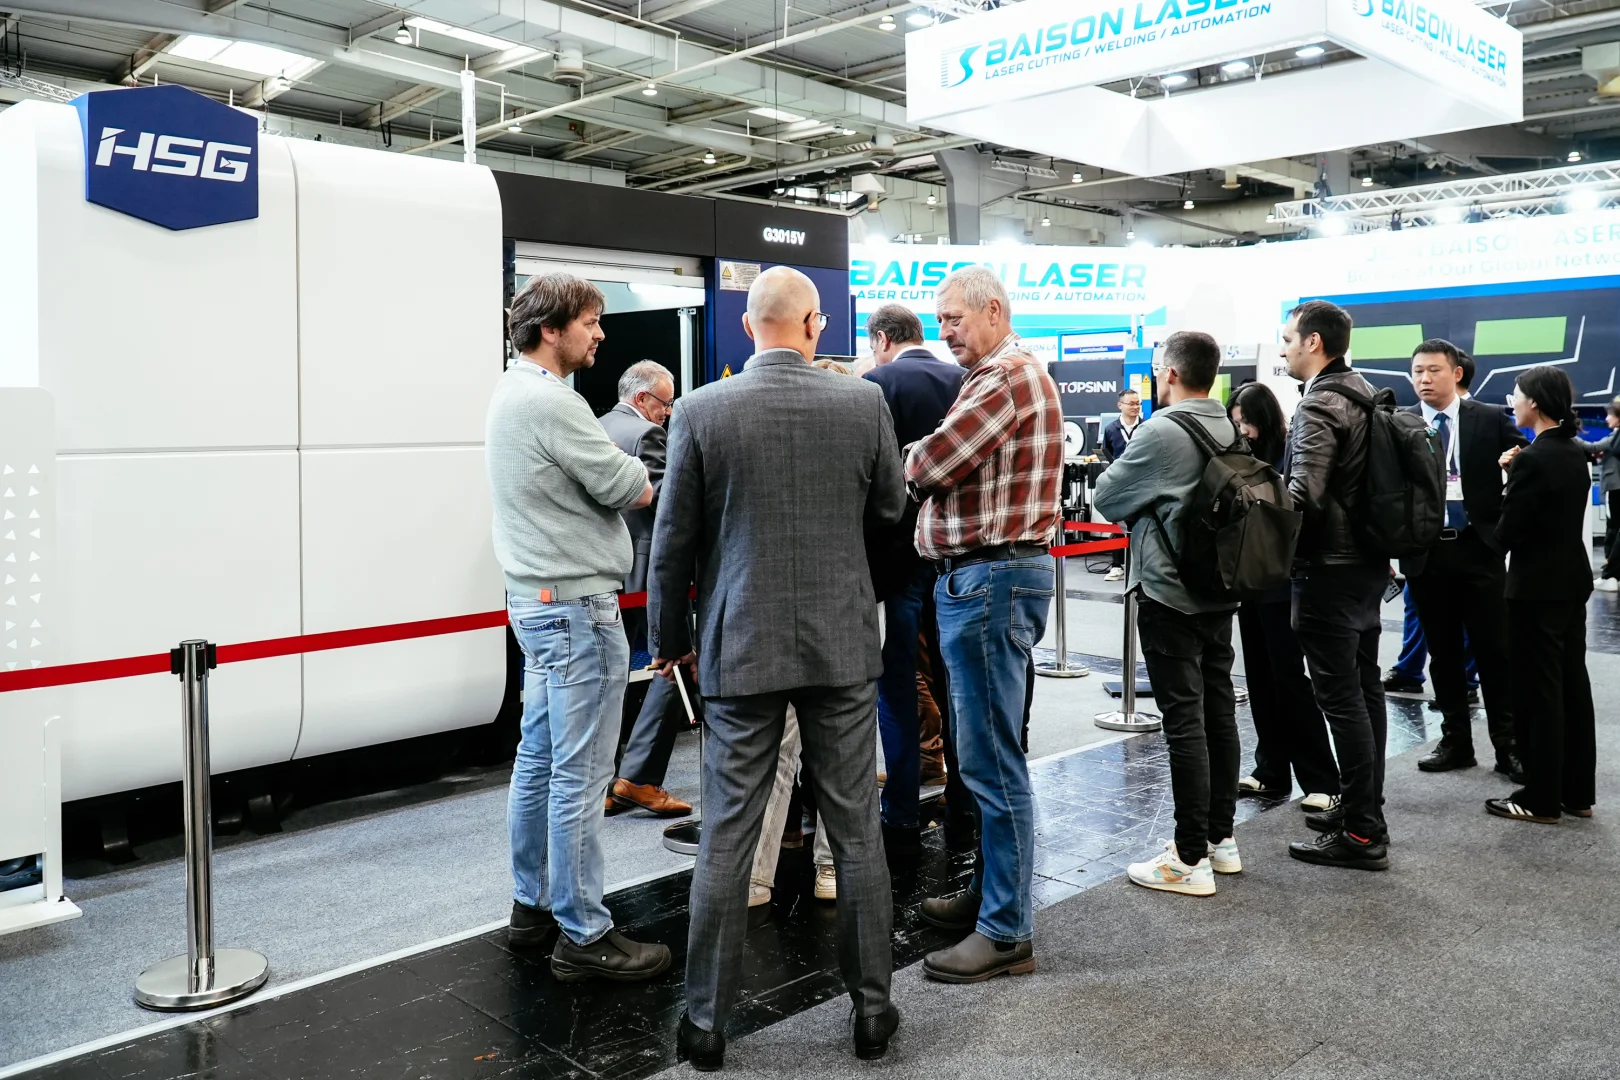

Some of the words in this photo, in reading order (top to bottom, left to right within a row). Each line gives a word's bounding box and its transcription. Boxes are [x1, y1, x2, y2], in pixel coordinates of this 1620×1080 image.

[985, 6, 1125, 67] BAISON
[1133, 0, 1250, 30] LAS
[985, 62, 1024, 80] LASER
[1027, 47, 1081, 70] CUTTING
[1094, 31, 1157, 55] WELDING
[1171, 2, 1272, 36] AUTOMATION
[1457, 27, 1507, 75] LASER
[95, 126, 252, 183] HSG
[763, 227, 806, 246] G3015V
[1430, 232, 1511, 257] BAISO
[1553, 222, 1620, 245] ASER
[1018, 262, 1148, 288] LASER
[850, 289, 897, 300] ASER
[1054, 291, 1146, 301] AUTOMATION
[1058, 380, 1117, 394] TOPSINN
